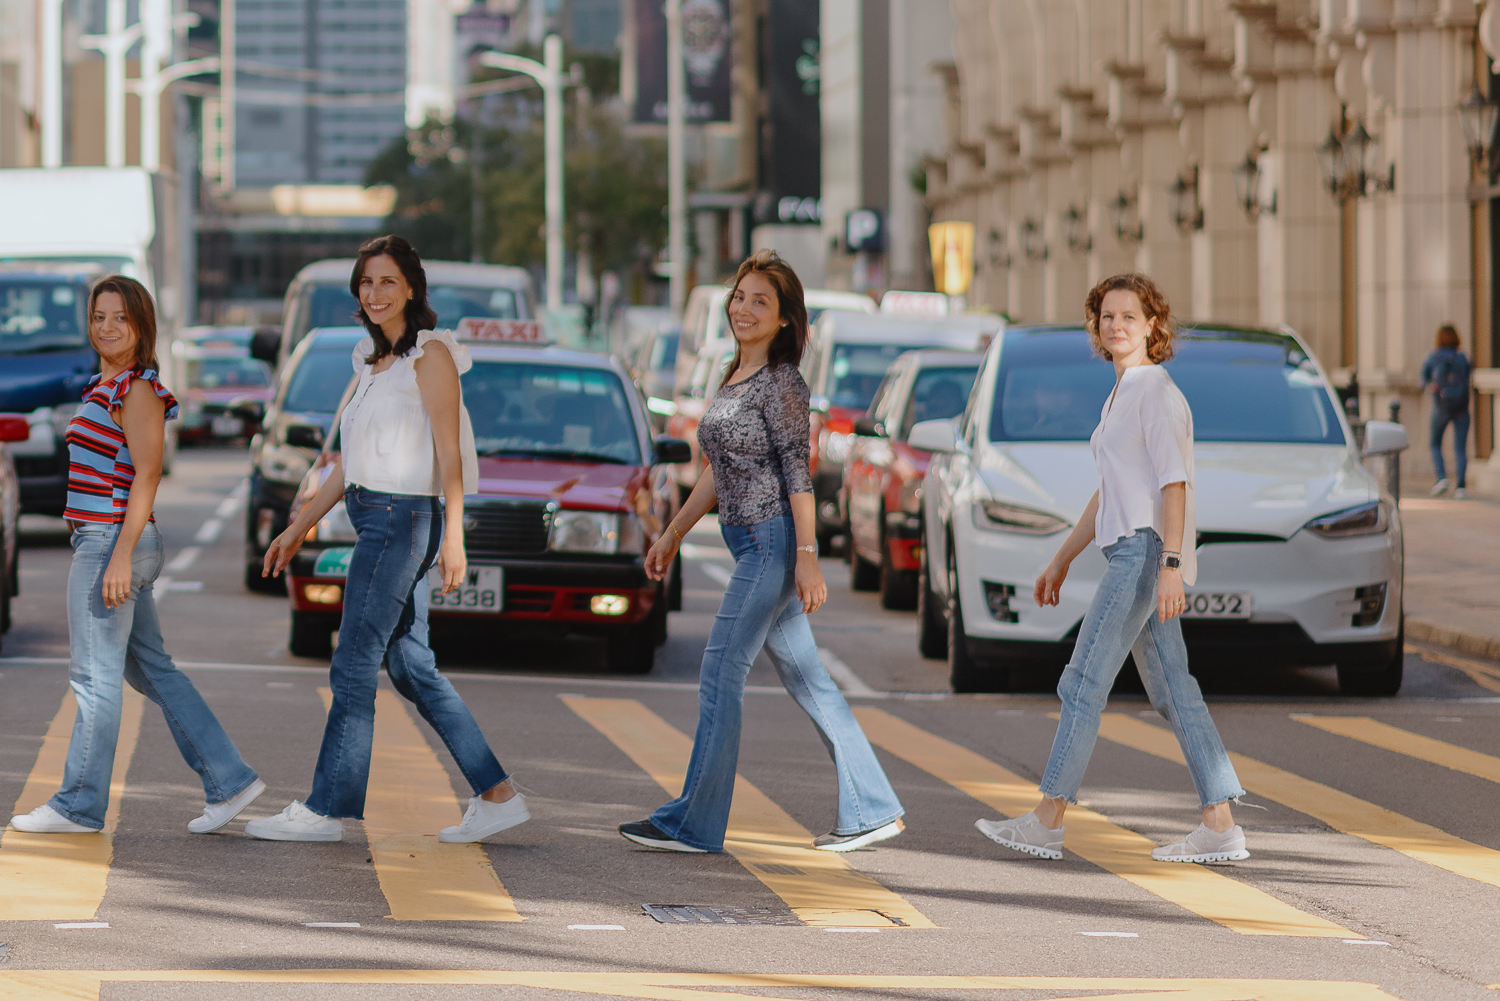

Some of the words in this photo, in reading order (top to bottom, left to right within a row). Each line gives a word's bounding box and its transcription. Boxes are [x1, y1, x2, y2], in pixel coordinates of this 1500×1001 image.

[779, 197, 822, 221] FA
[847, 209, 879, 248] P
[466, 321, 539, 339] TAXI
[431, 588, 496, 607] 6338
